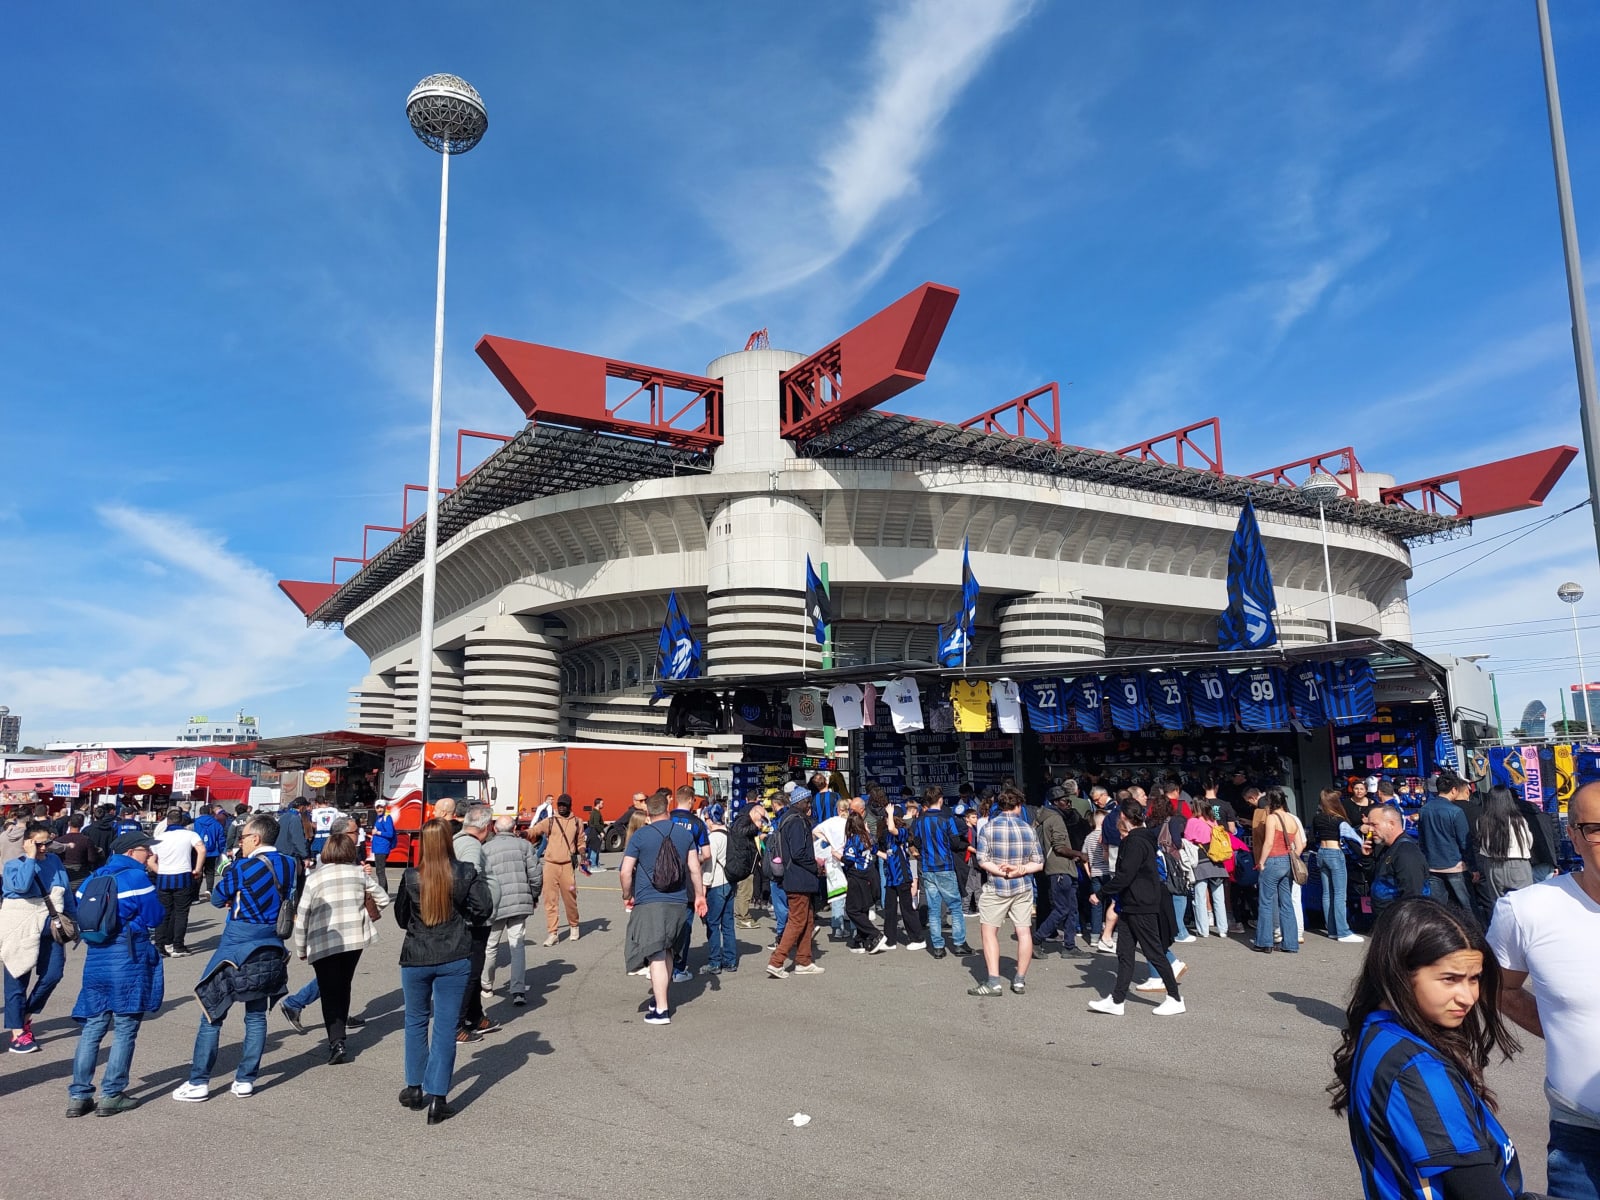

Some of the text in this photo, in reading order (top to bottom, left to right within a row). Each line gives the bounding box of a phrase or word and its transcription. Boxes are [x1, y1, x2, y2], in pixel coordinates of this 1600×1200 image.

[1037, 690, 1057, 708] 22
[1124, 683, 1138, 705] 9
[1163, 685, 1181, 705] 23
[1201, 678, 1224, 699] 10
[1250, 680, 1275, 701] 99
[1304, 679, 1320, 701] 21
[1083, 690, 1099, 709] 32
[1526, 768, 1540, 799] FORZA
